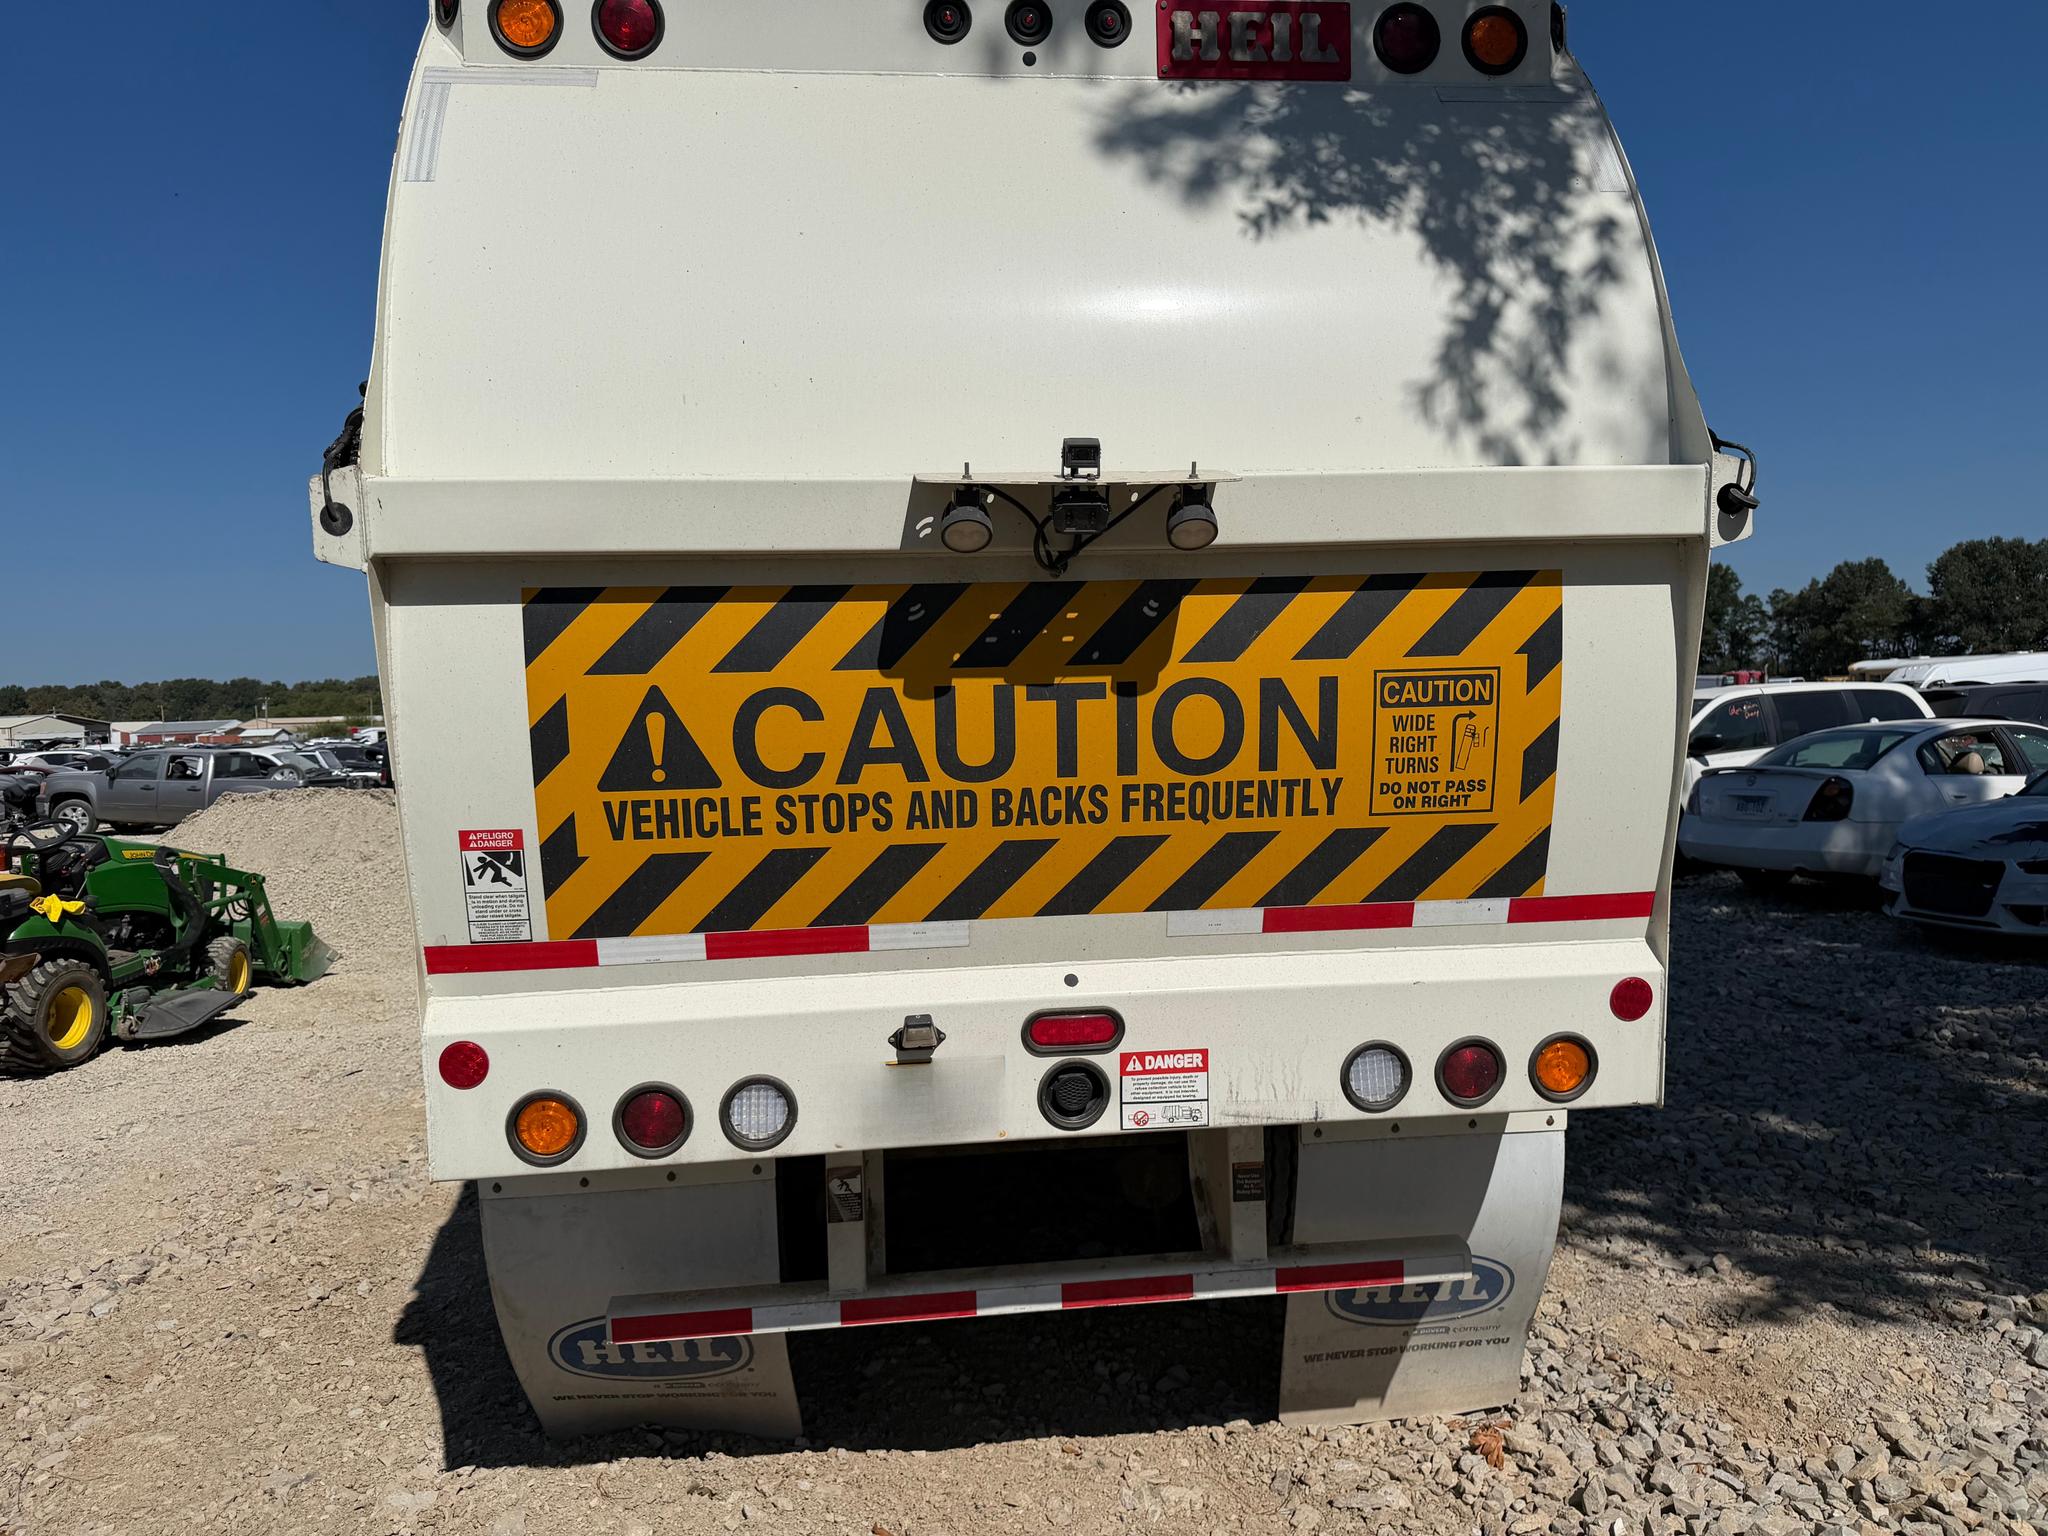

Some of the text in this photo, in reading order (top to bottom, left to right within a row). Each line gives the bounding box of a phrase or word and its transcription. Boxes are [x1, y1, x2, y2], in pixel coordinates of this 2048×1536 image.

[1171, 10, 1340, 62] HEIL
[1383, 679, 1491, 704] CAUTION
[1392, 714, 1436, 732] WIDE
[732, 676, 1338, 789] CAUTION
[1389, 735, 1438, 754] RIGHT
[1385, 756, 1439, 774] TURNS
[1380, 779, 1487, 795] DO NOT PASS
[603, 777, 1344, 841] VEHICLE STOPS AND BACKS FREQUENTLY
[1393, 795, 1471, 809] ON RIGHT
[477, 832, 514, 840] PELIGRO
[477, 840, 513, 848] DANGER
[1145, 1053, 1203, 1070] DANGER
[1352, 1272, 1489, 1304] HEIL
[1453, 1324, 1501, 1335] company
[577, 1338, 732, 1365] HEIL
[1303, 1336, 1511, 1363] WE NEVER STOP WORKING FOR YOU
